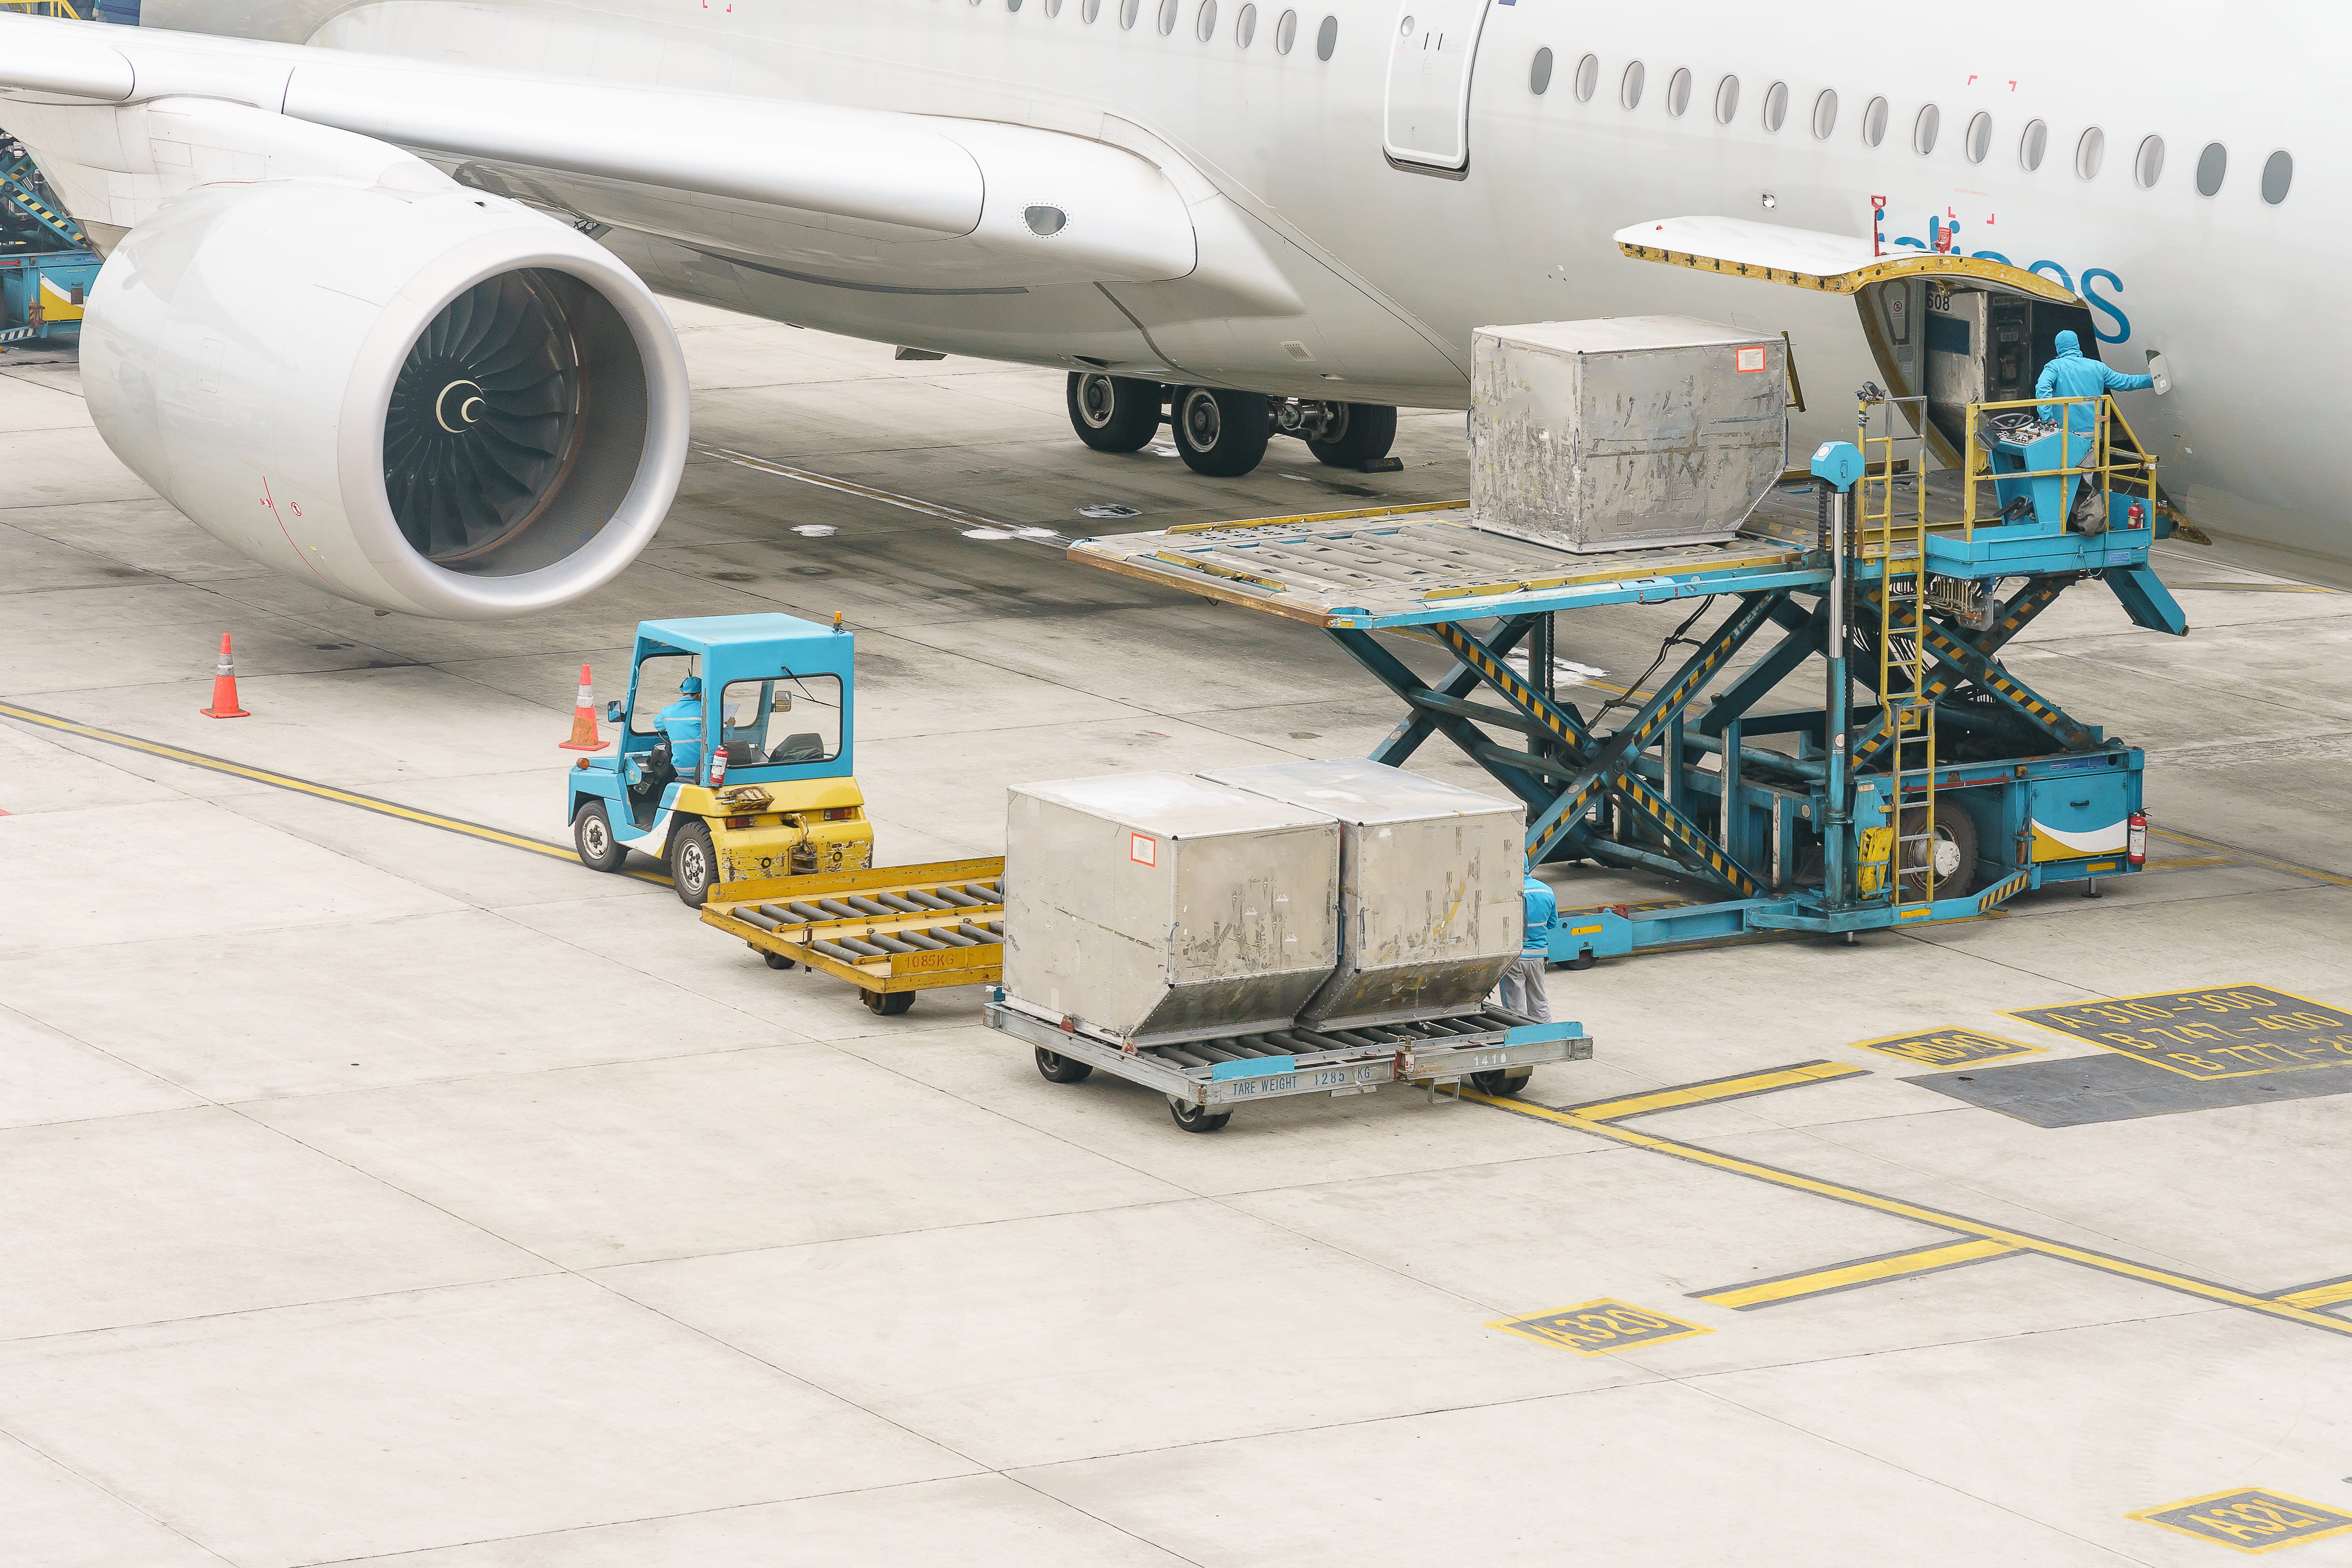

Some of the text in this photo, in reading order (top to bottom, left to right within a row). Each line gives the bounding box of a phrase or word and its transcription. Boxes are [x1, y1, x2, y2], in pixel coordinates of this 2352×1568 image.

[1927, 292, 1950, 312] 608
[2044, 991, 2277, 1029] A 310-300
[2099, 1012, 2344, 1049] B 747-400
[1474, 1053, 1507, 1066] 1410
[1881, 1034, 2009, 1062] MD90
[2166, 1053, 2226, 1071] B
[1233, 1066, 1370, 1095] TARE WEIGHT 1285 KG
[1529, 1309, 1670, 1347] A320
[2187, 1499, 2329, 1540] A321
